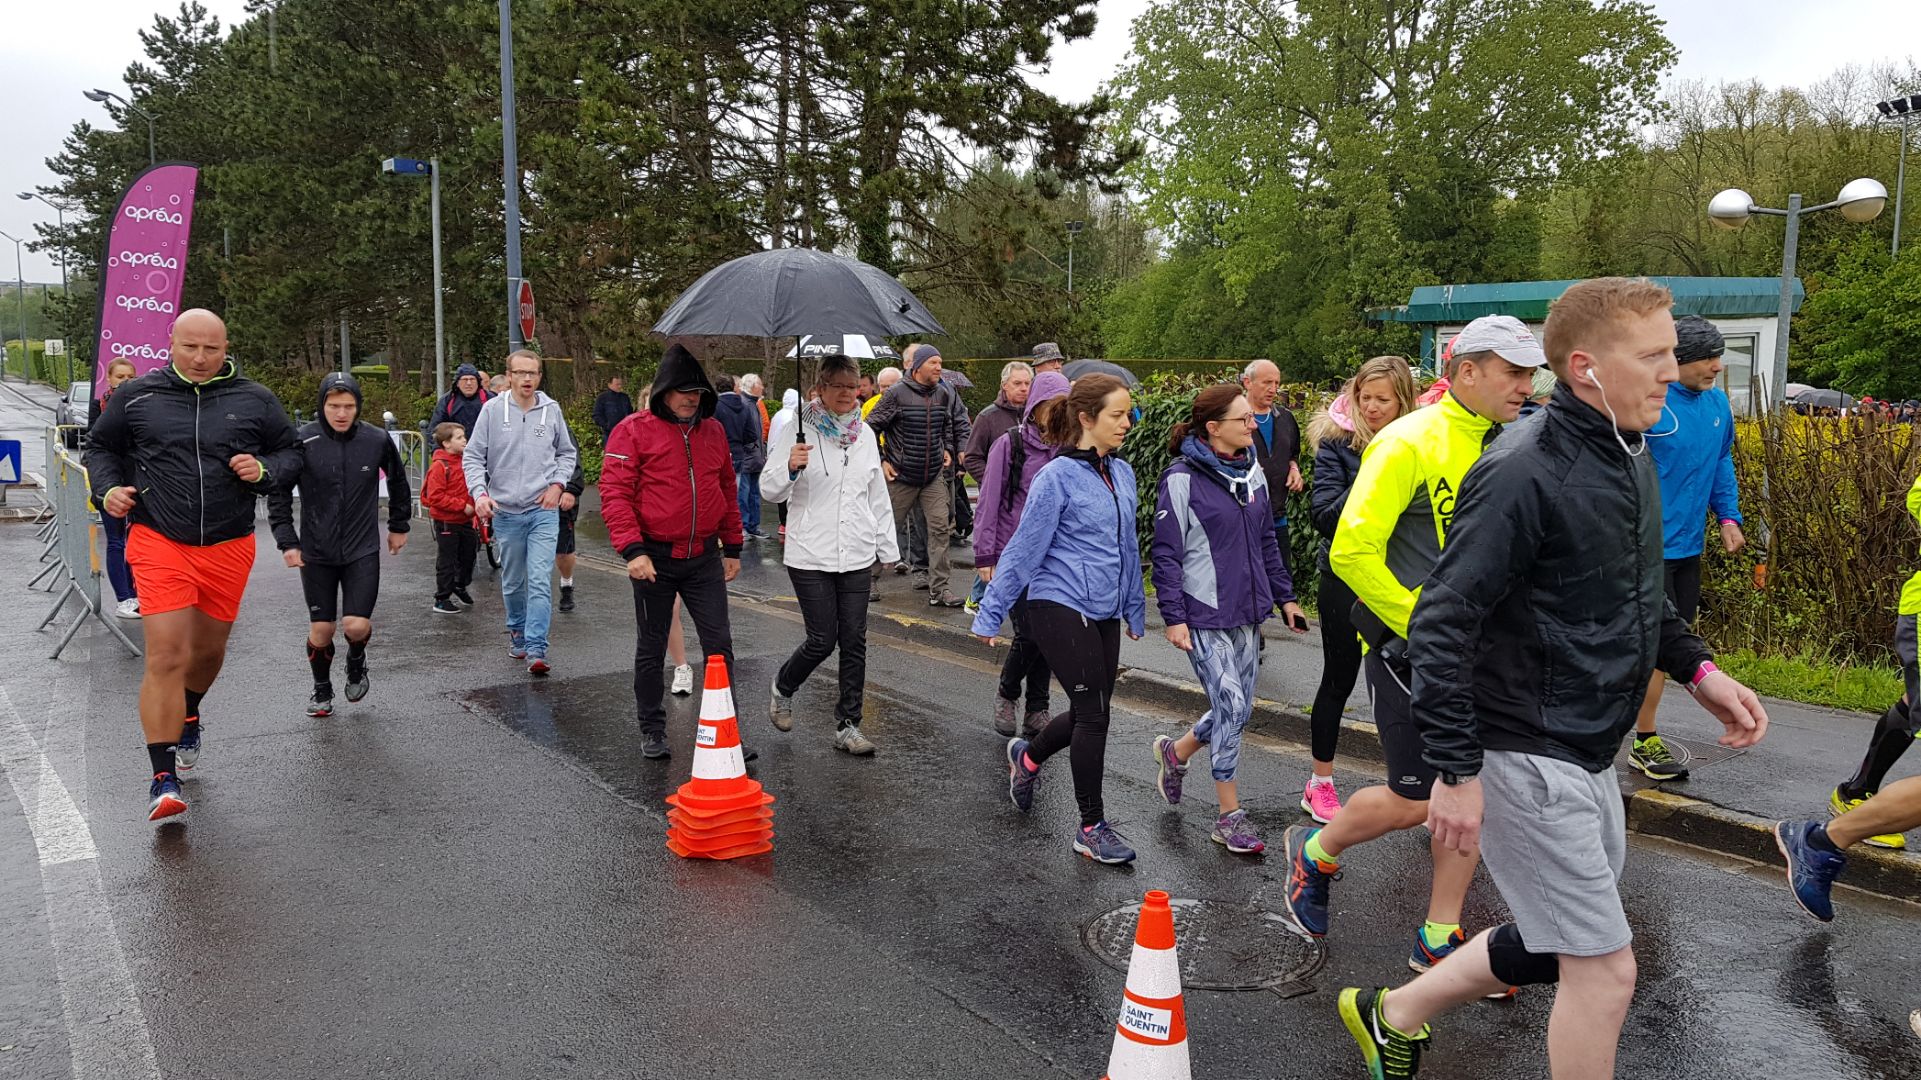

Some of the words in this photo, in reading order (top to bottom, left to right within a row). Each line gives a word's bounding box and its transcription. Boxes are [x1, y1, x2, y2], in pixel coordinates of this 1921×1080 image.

[124, 205, 183, 225] apréva
[120, 250, 178, 270] apréva
[116, 294, 174, 314] apréva
[520, 302, 533, 320] STOP
[110, 342, 170, 360] apréva
[803, 344, 841, 354] PING
[1126, 1005, 1154, 1022] SAINT
[1125, 1015, 1168, 1035] QUENTIN
